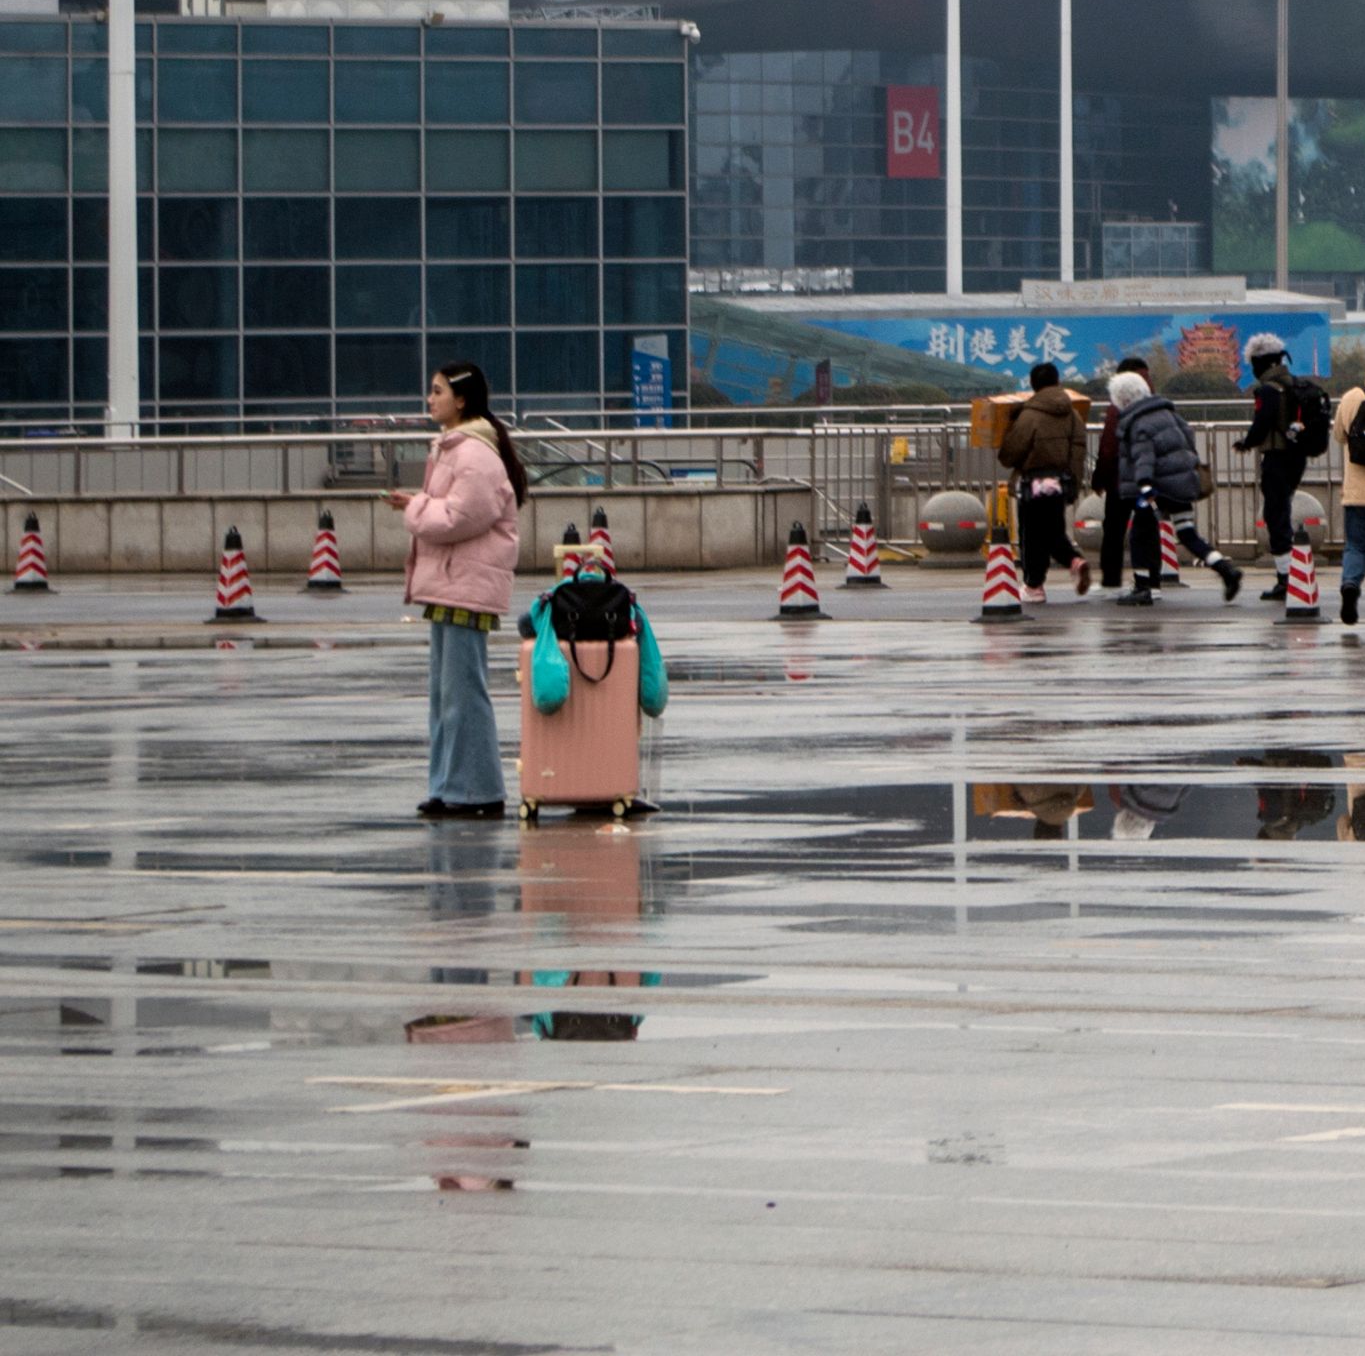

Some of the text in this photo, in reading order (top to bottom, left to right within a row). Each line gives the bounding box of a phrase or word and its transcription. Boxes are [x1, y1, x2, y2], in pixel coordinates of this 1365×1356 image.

[893, 110, 935, 155] B4
[925, 321, 1078, 365] 荆楚美食
